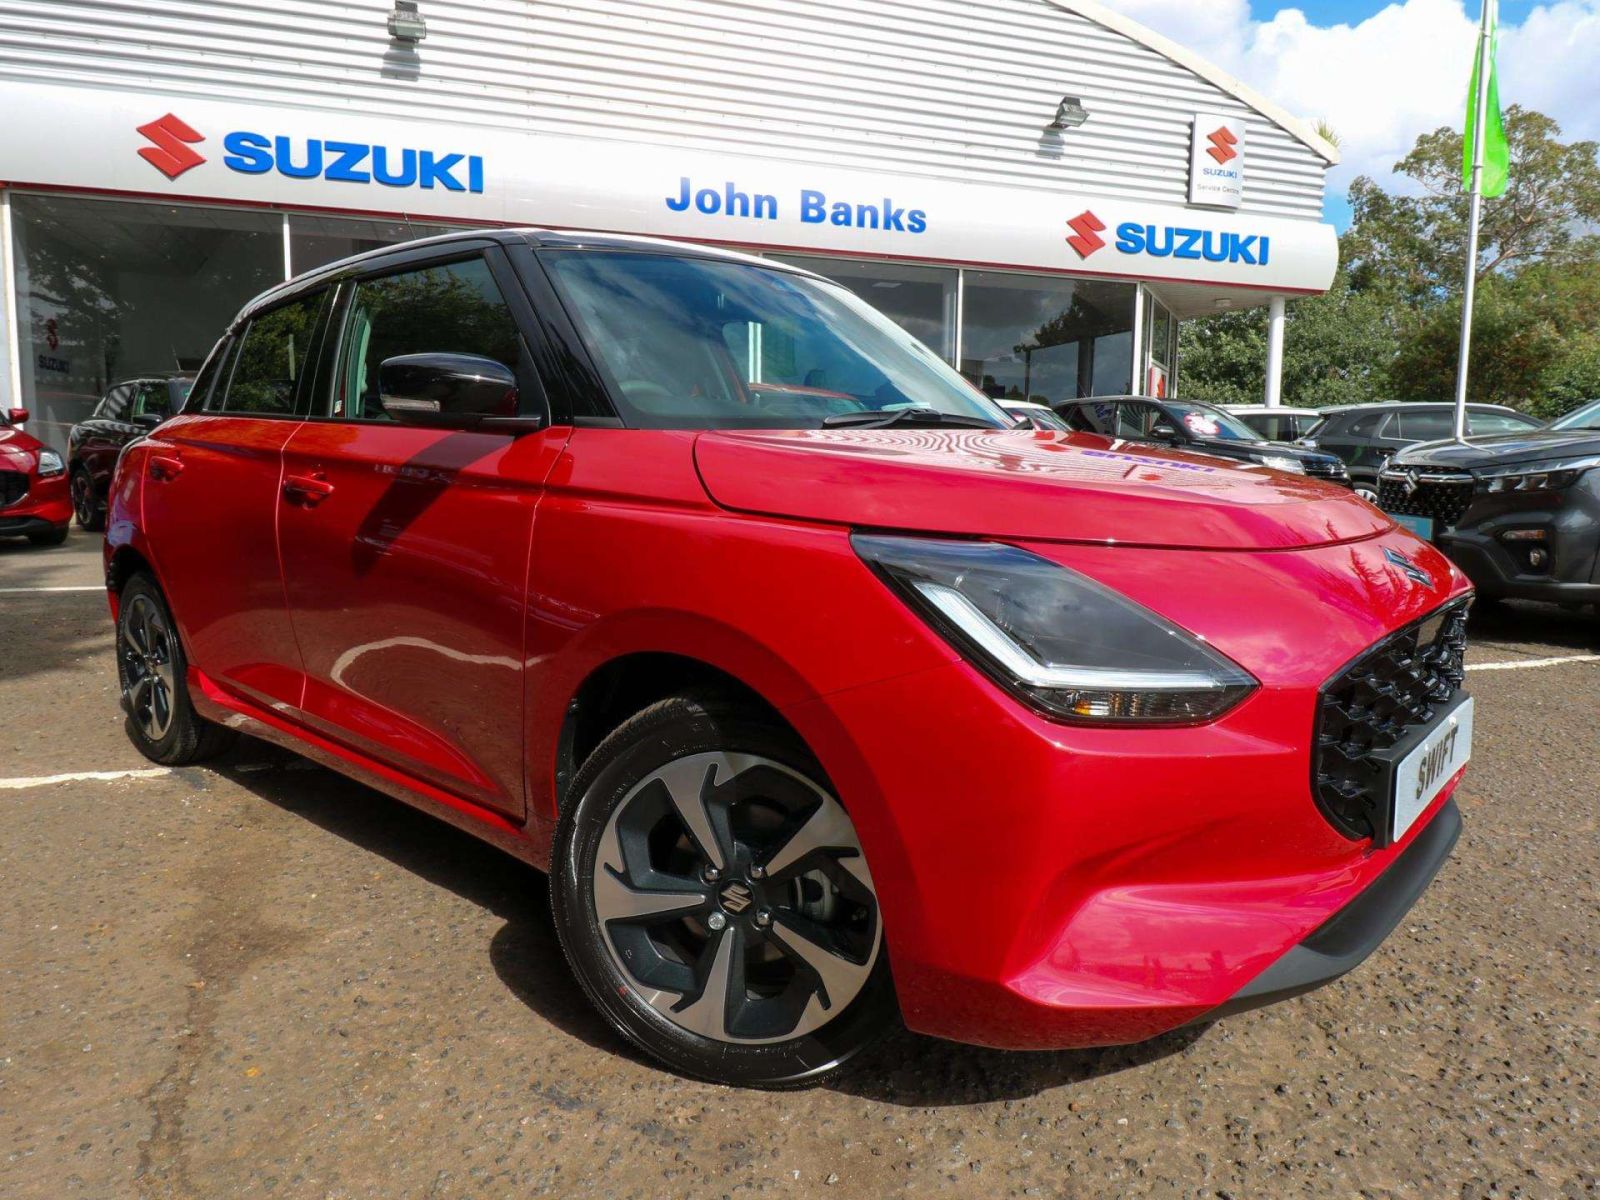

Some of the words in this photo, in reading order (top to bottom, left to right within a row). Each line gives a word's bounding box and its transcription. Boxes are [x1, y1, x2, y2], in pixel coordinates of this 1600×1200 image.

[223, 131, 484, 193] SUZUKI
[1202, 167, 1238, 179] SUZUKI
[666, 177, 778, 220] John
[801, 190, 927, 235] Banks
[1197, 183, 1221, 192] Service
[1115, 222, 1270, 265] SUZUKI
[1415, 724, 1459, 800] SWIFT
